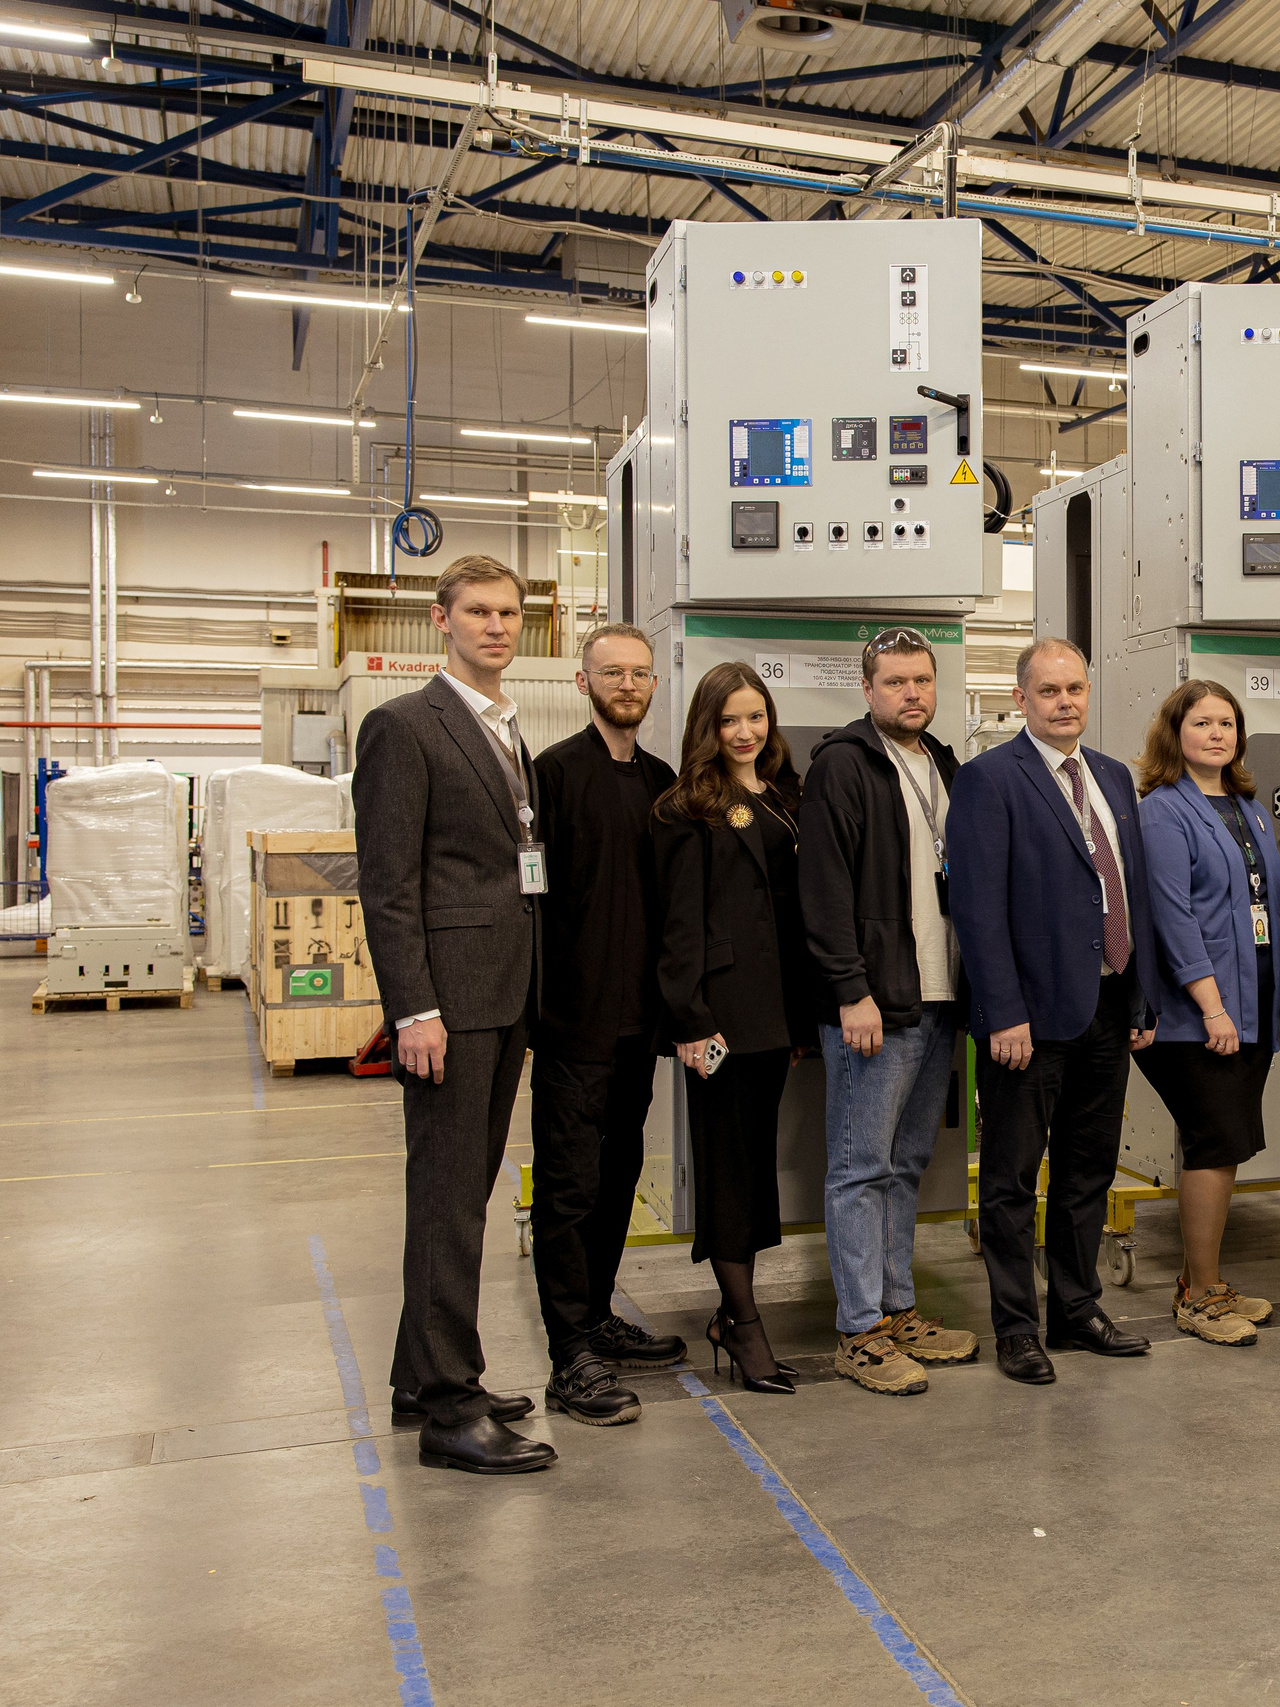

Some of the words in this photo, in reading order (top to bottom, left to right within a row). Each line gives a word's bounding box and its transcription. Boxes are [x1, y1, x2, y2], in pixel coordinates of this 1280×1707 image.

[924, 628, 959, 638] MVnex
[388, 660, 440, 673] Kvadrat
[760, 662, 784, 679] 36
[1250, 675, 1269, 691] 39
